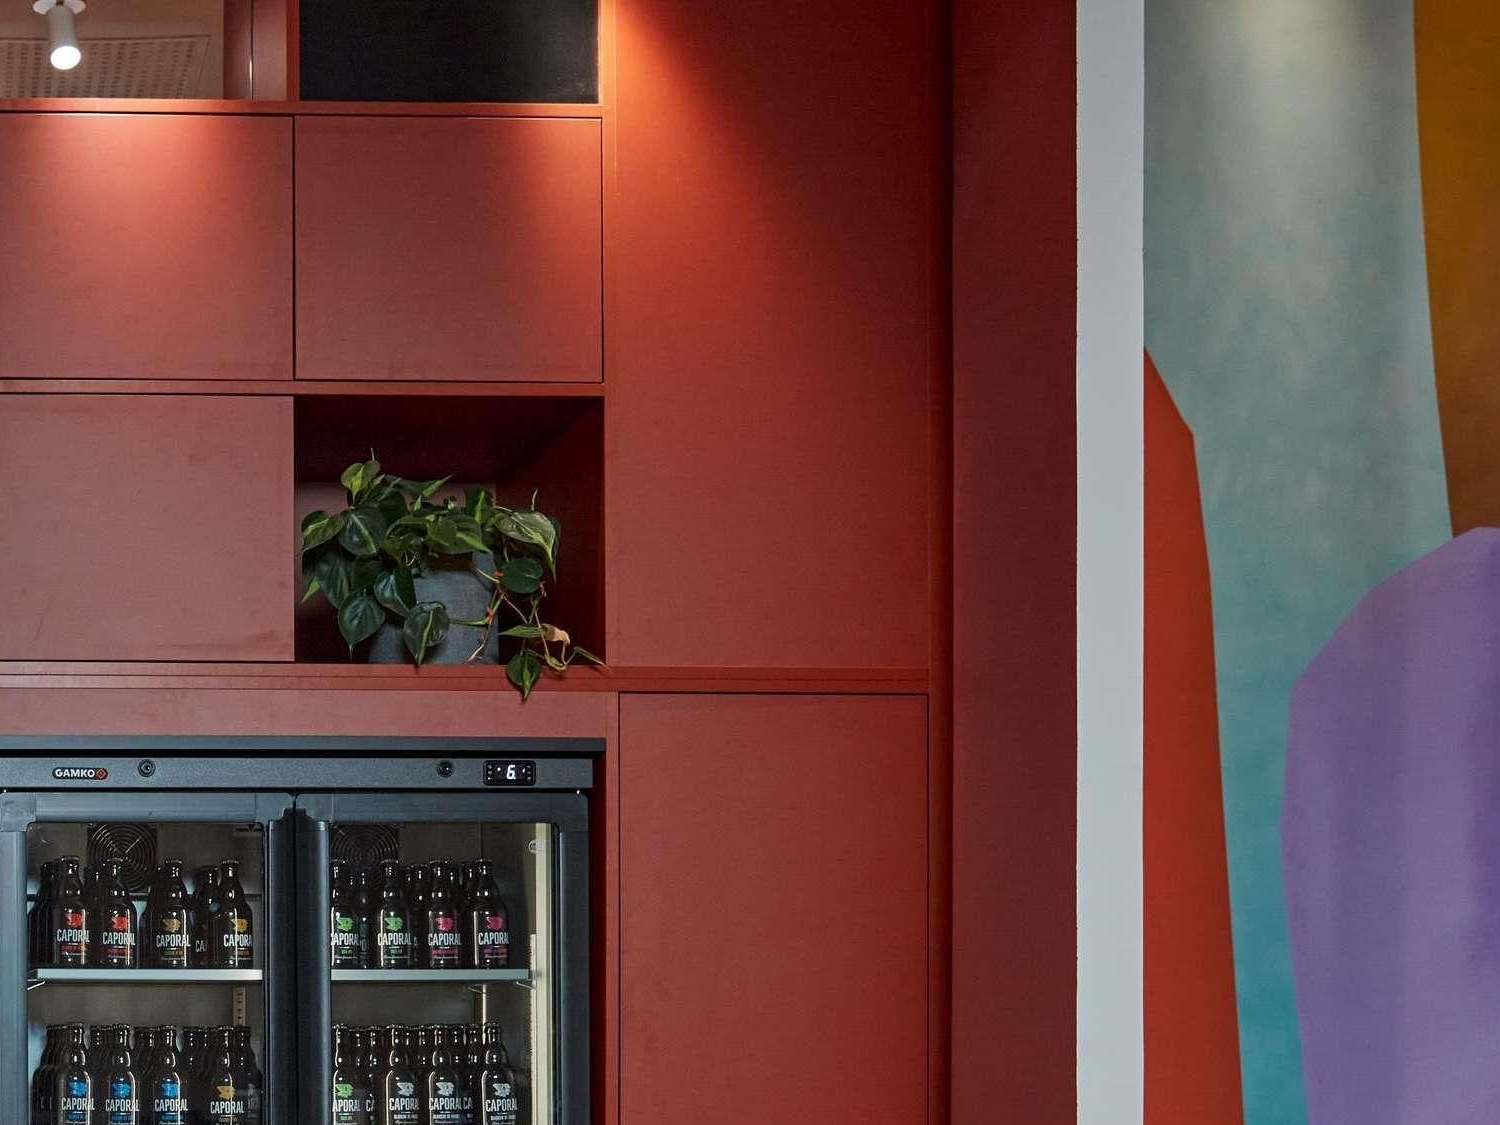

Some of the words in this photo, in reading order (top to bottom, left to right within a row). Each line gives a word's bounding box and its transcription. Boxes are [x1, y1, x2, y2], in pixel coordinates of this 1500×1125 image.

[55, 768, 95, 778] GAMKO
[156, 934, 191, 947] CAPORAL
[377, 933, 412, 945] CAPORAL
[428, 933, 462, 946] CAPORAL
[61, 1098, 95, 1111] CAPORAL
[105, 1099, 140, 1112] CAPORAL
[154, 1099, 188, 1111] CAPORAL
[210, 1101, 245, 1114] CAPORAL
